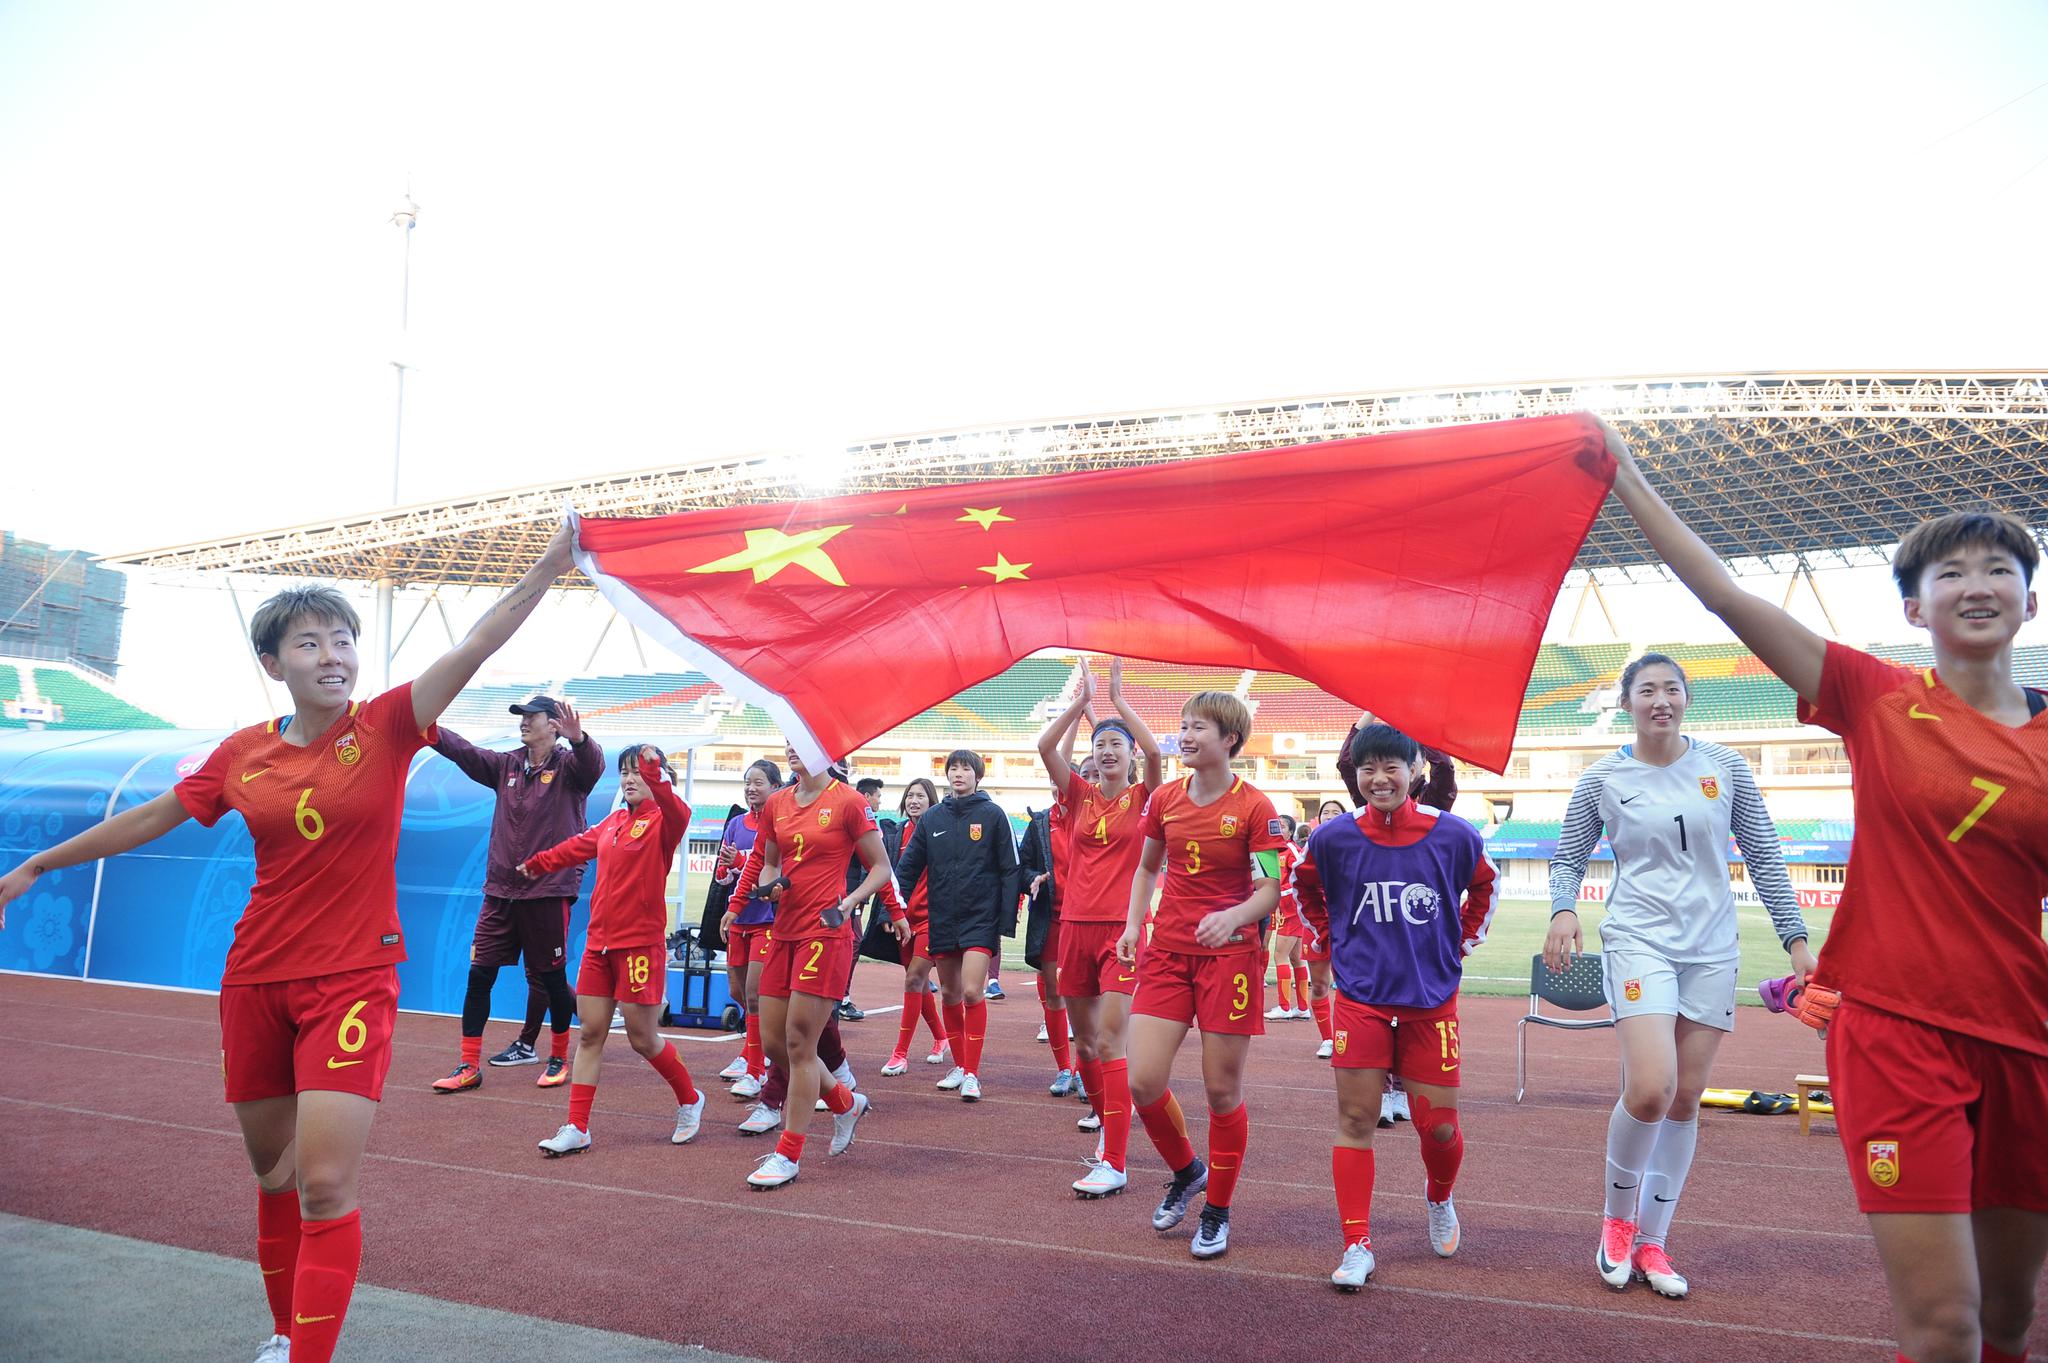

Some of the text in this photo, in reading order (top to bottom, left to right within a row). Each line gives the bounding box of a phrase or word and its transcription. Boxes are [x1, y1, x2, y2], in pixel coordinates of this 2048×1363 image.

[295, 788, 324, 841] 6
[1947, 776, 2006, 843] 7
[793, 833, 804, 862] 2
[1095, 816, 1107, 844] 4
[1674, 814, 1687, 851] 1
[1185, 840, 1201, 875] 3
[1352, 881, 1434, 925] AFC
[626, 955, 649, 984] 18
[804, 941, 823, 972] 2
[1232, 973, 1249, 1010] 3
[337, 1000, 368, 1052] 6
[1435, 1021, 1458, 1059] 15
